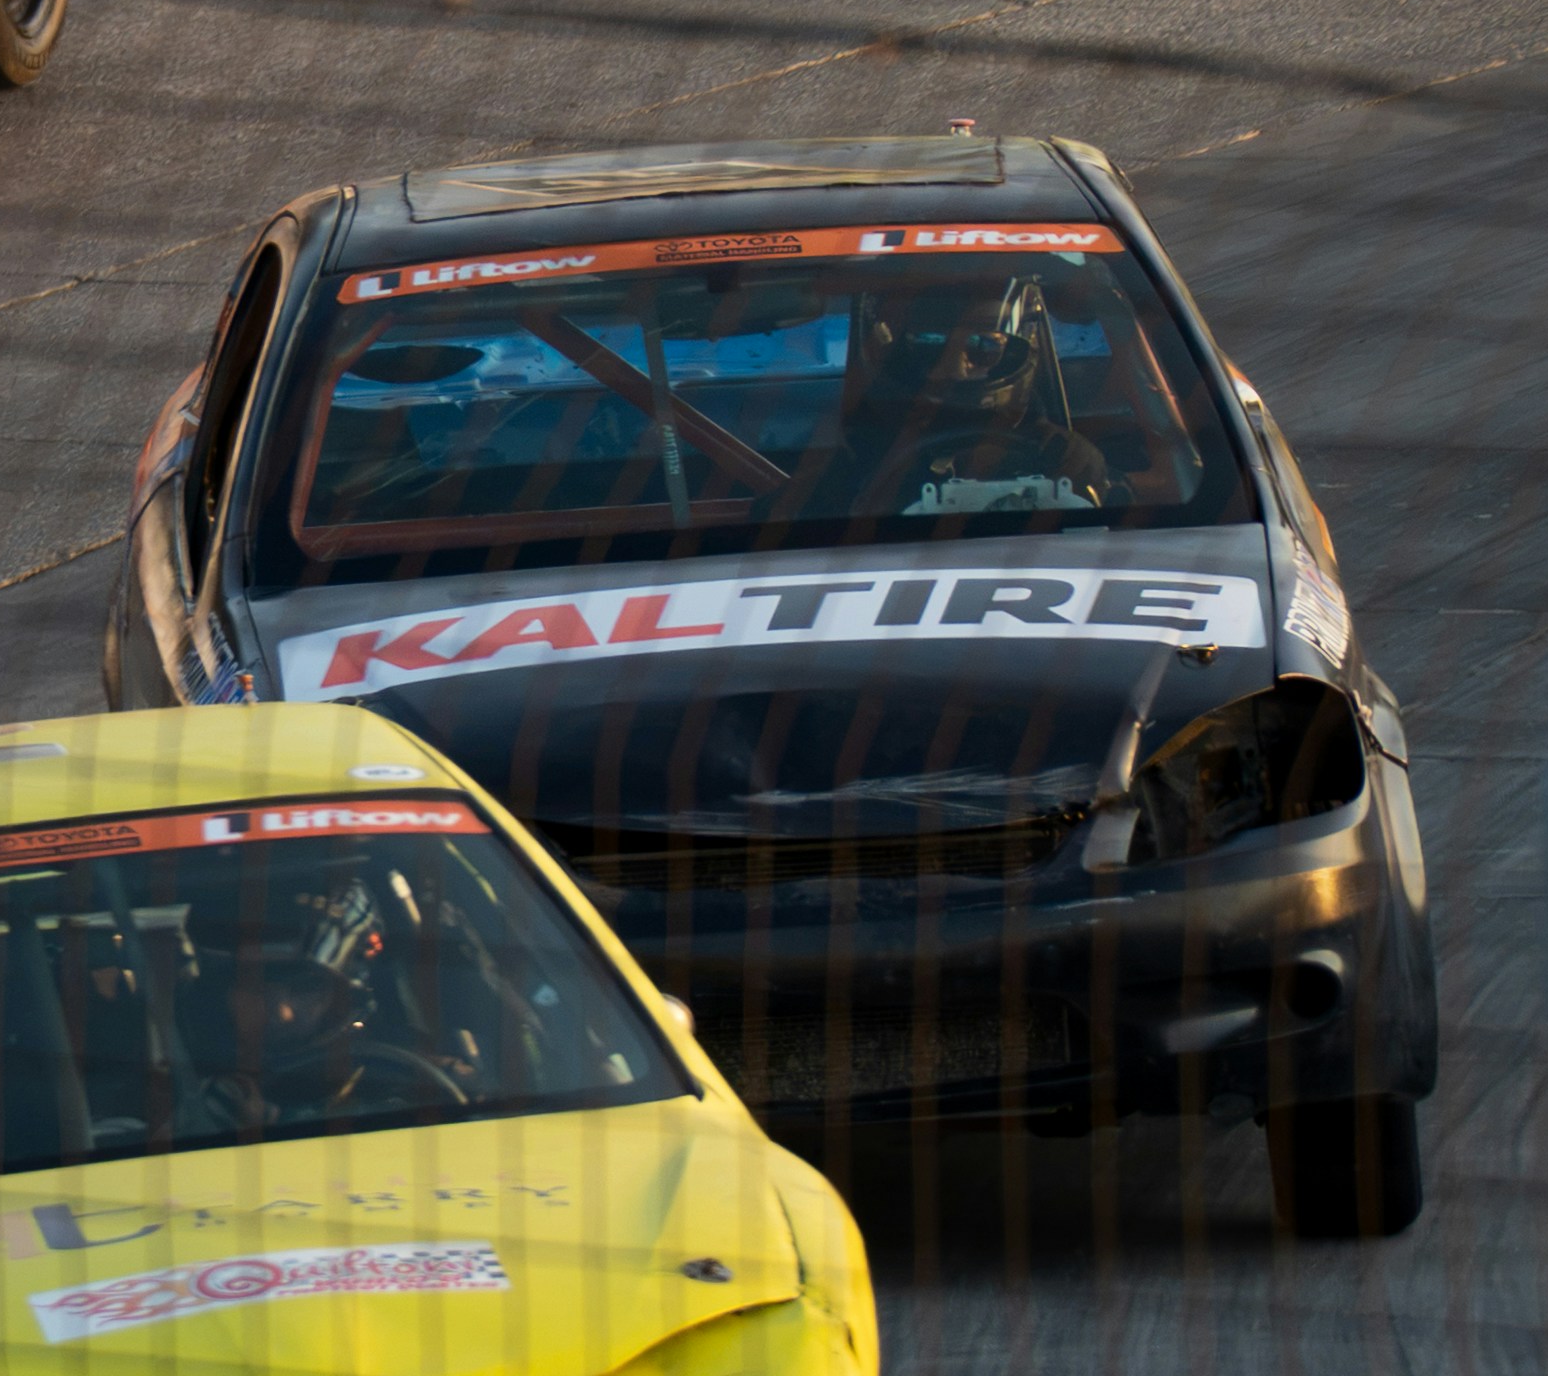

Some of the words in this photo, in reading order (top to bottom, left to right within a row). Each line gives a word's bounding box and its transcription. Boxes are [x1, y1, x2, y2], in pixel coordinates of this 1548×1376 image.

[698, 235, 801, 249] TOYOTA
[915, 230, 1102, 247] Liftow
[412, 253, 596, 287] Liftow
[262, 808, 463, 832] Liftow
[20, 825, 139, 845] TOYOTA
